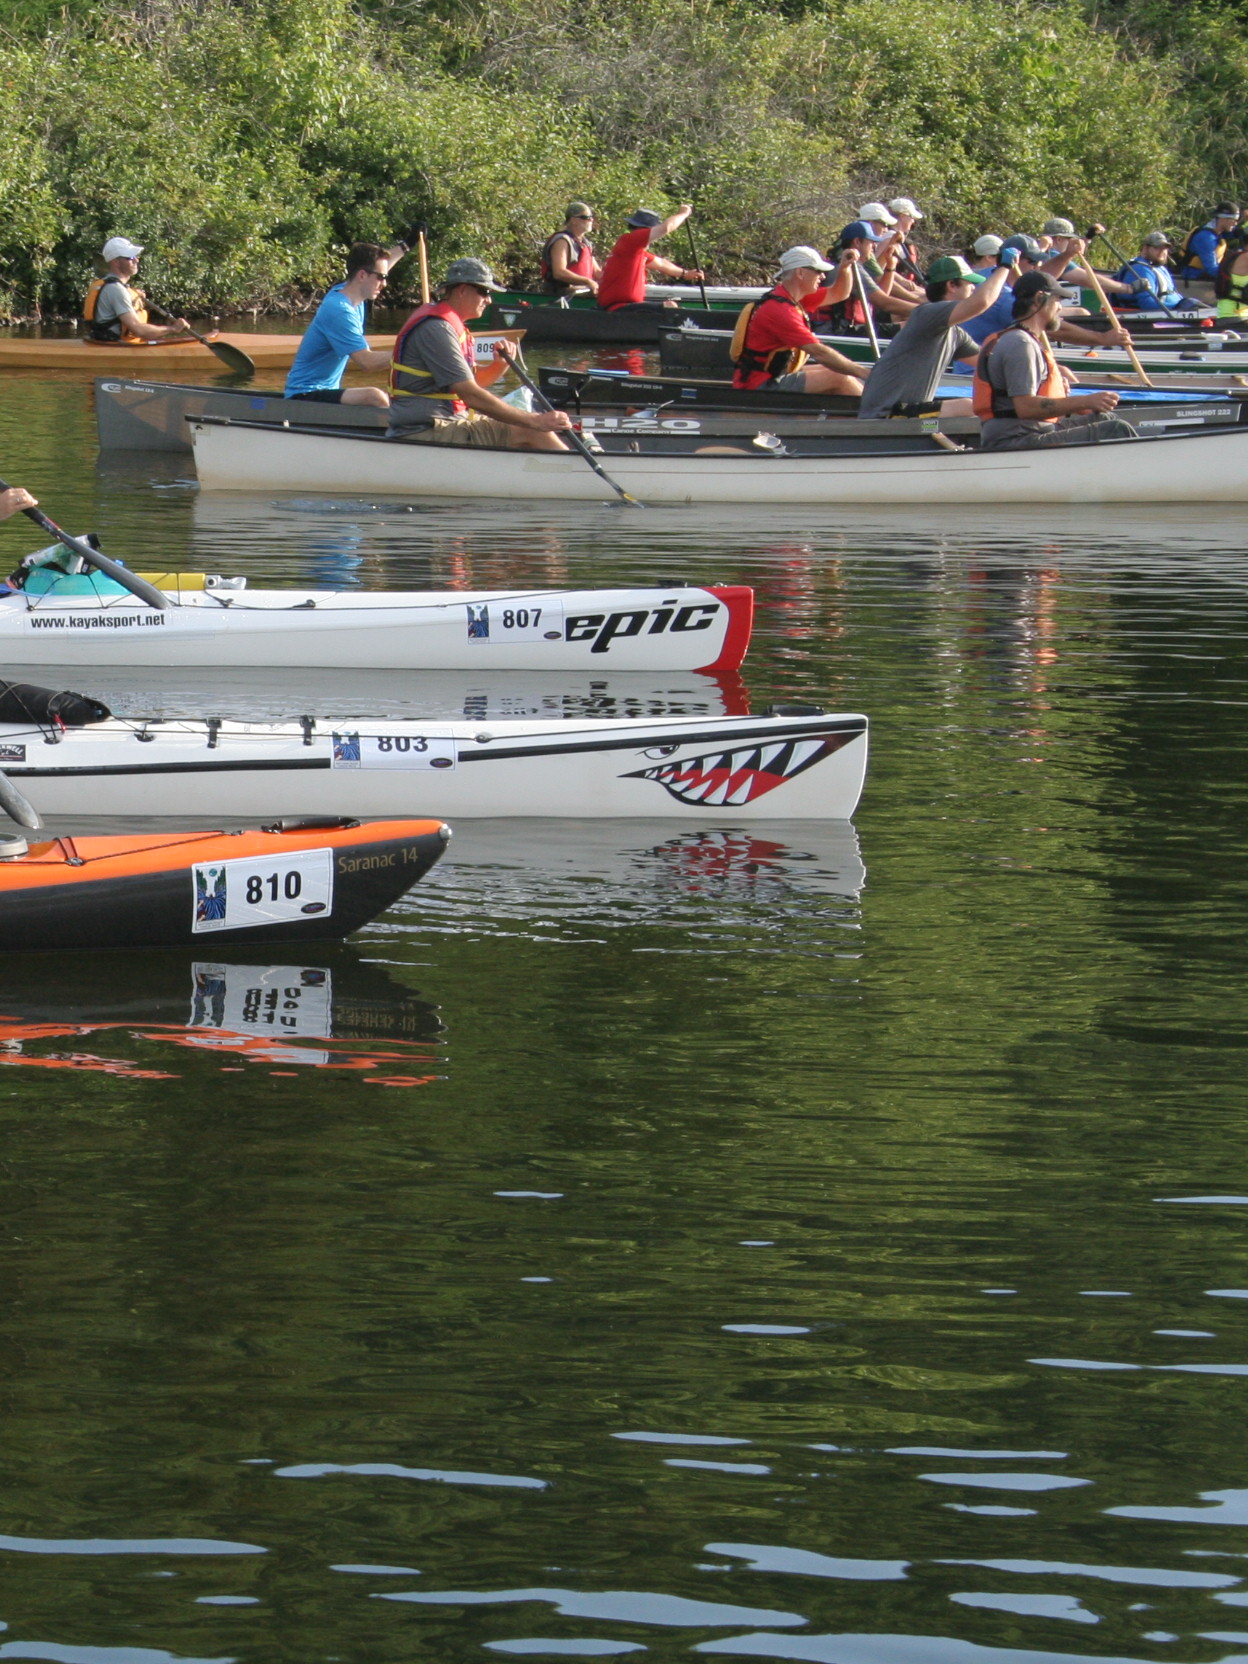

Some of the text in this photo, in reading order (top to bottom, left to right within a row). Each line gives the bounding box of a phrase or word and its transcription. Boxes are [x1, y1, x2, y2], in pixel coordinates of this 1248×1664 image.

[477, 344, 495, 353] 809
[1176, 409, 1216, 417] SLINGSHOT
[31, 614, 165, 629] www.kayaksport.net
[503, 609, 542, 628] 807
[566, 600, 720, 653] epic
[378, 735, 428, 752] 803
[338, 847, 418, 874] Saranac 14
[246, 870, 302, 905] 810
